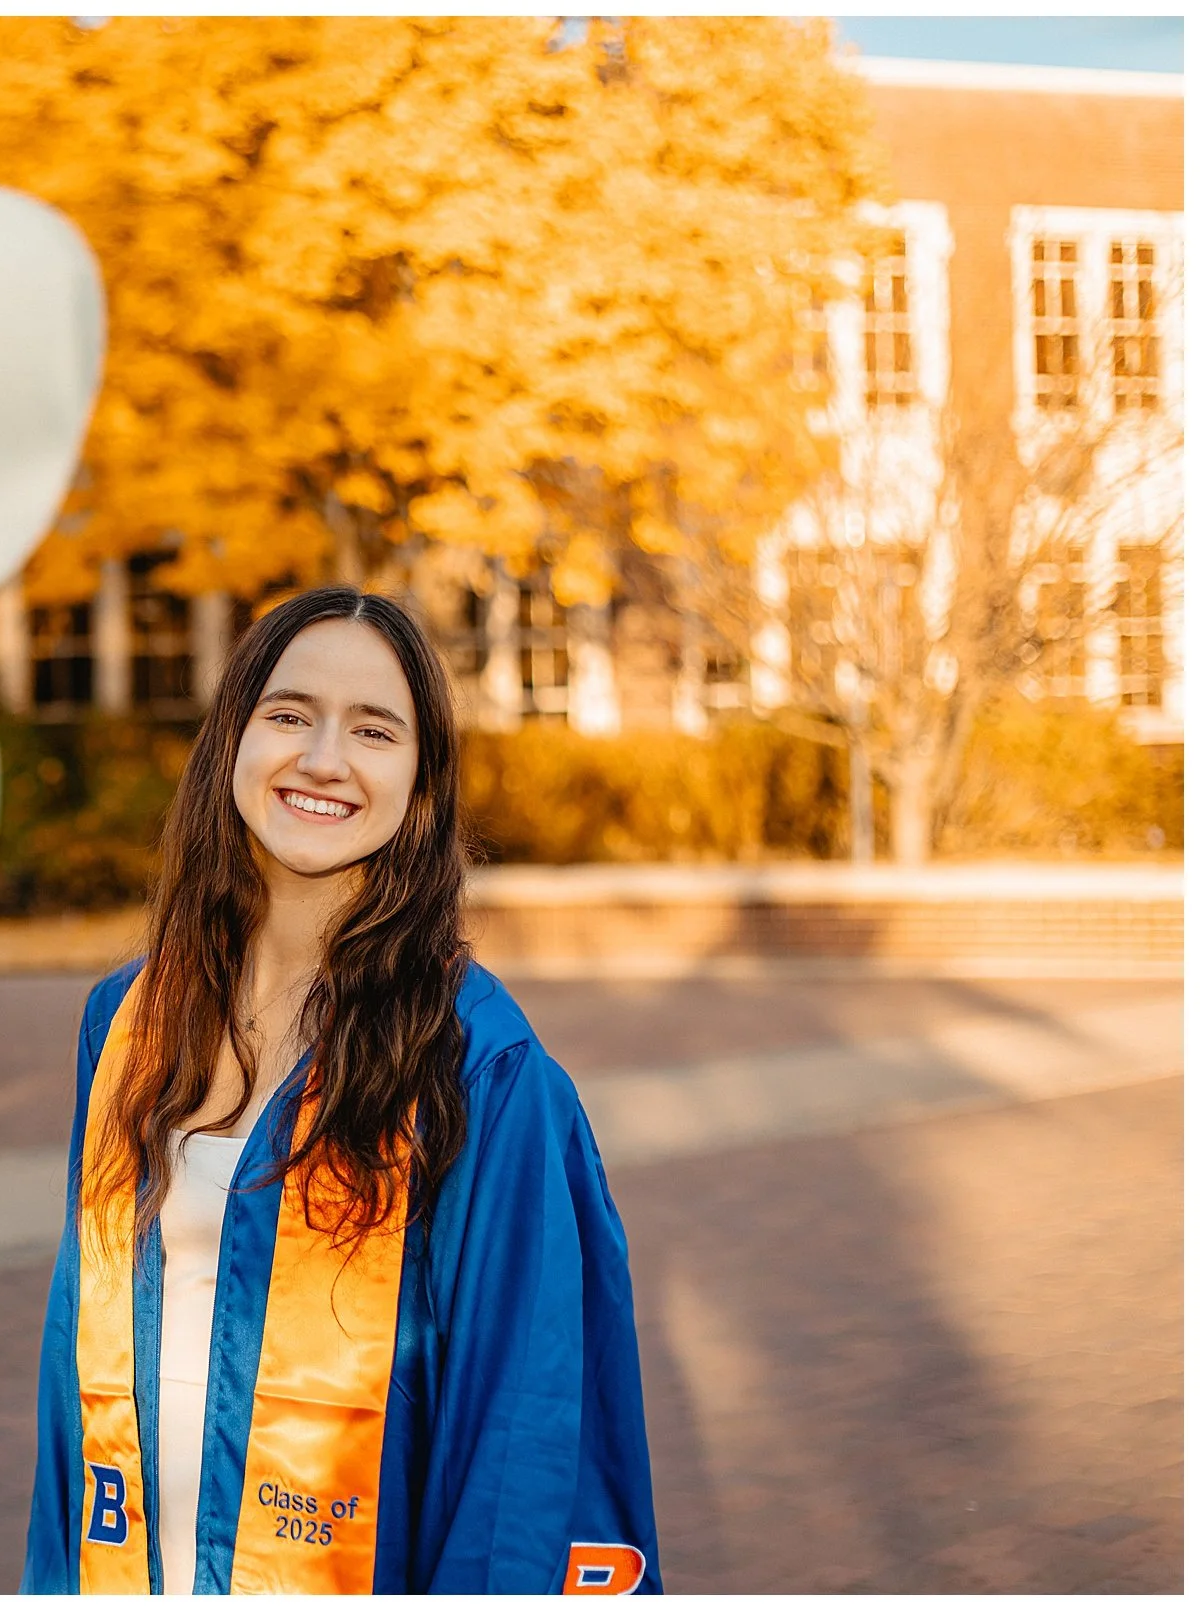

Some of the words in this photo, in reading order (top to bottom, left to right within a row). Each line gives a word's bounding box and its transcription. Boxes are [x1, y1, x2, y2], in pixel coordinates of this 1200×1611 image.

[87, 1463, 128, 1547] B
[258, 1483, 318, 1514] Class
[331, 1496, 359, 1520] of
[275, 1516, 333, 1546] 2025
